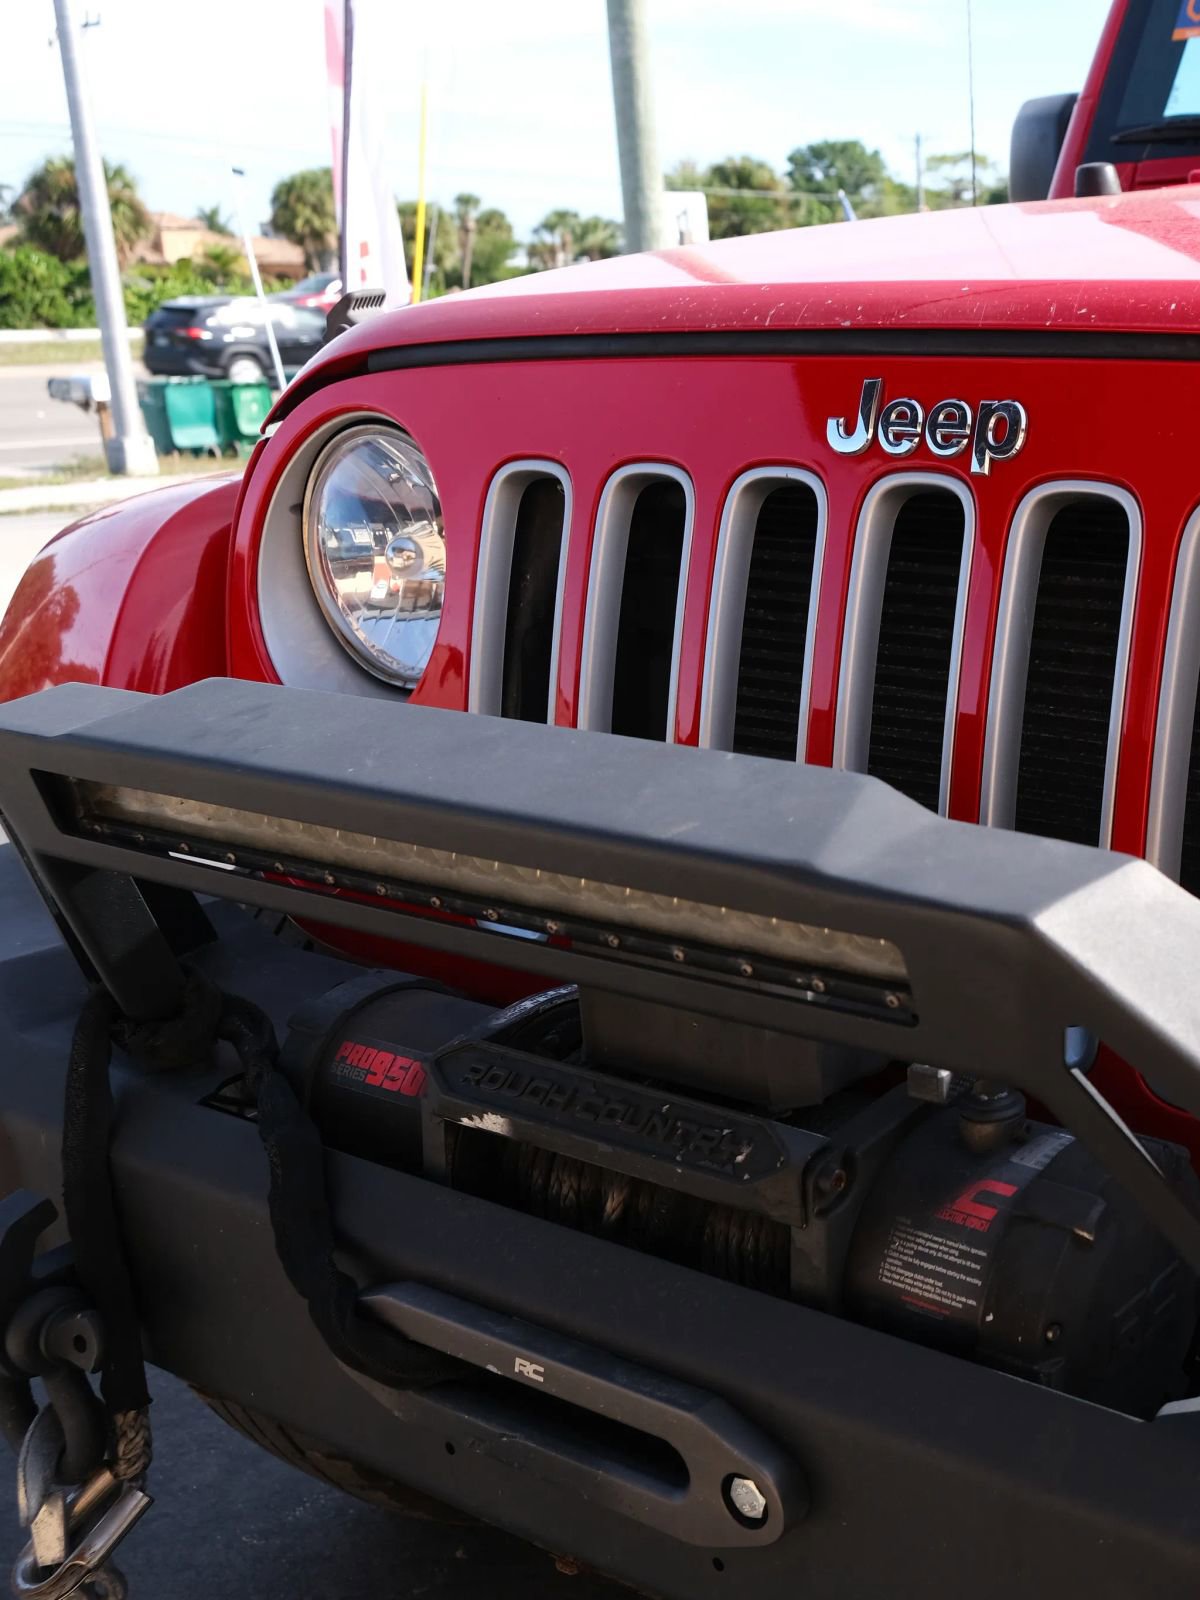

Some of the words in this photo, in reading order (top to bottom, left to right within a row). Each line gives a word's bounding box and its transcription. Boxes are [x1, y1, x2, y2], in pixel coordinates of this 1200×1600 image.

[826, 377, 1027, 476] Jeep
[330, 1062, 367, 1081] SERIES
[461, 1063, 578, 1112] ROUGH
[514, 1356, 545, 1383] RC
